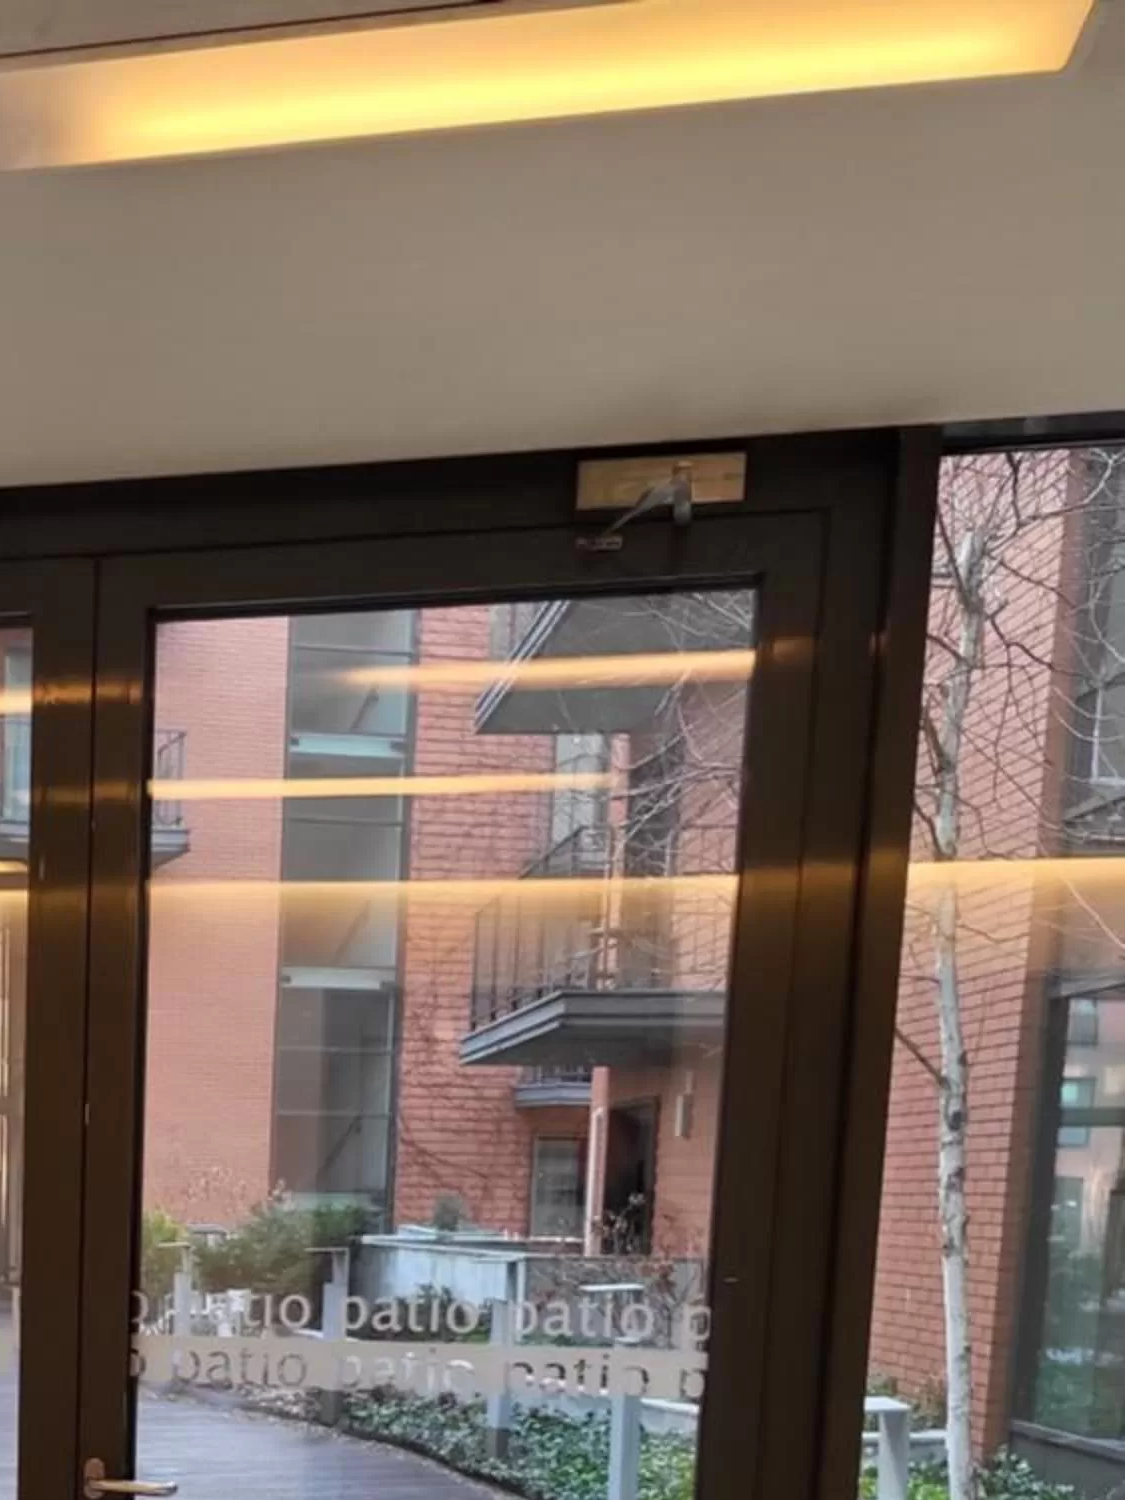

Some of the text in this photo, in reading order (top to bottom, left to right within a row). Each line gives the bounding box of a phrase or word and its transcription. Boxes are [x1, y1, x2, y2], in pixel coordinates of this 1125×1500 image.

[342, 1286, 478, 1340] patio
[515, 1292, 655, 1346] patio
[172, 1347, 308, 1389] patio
